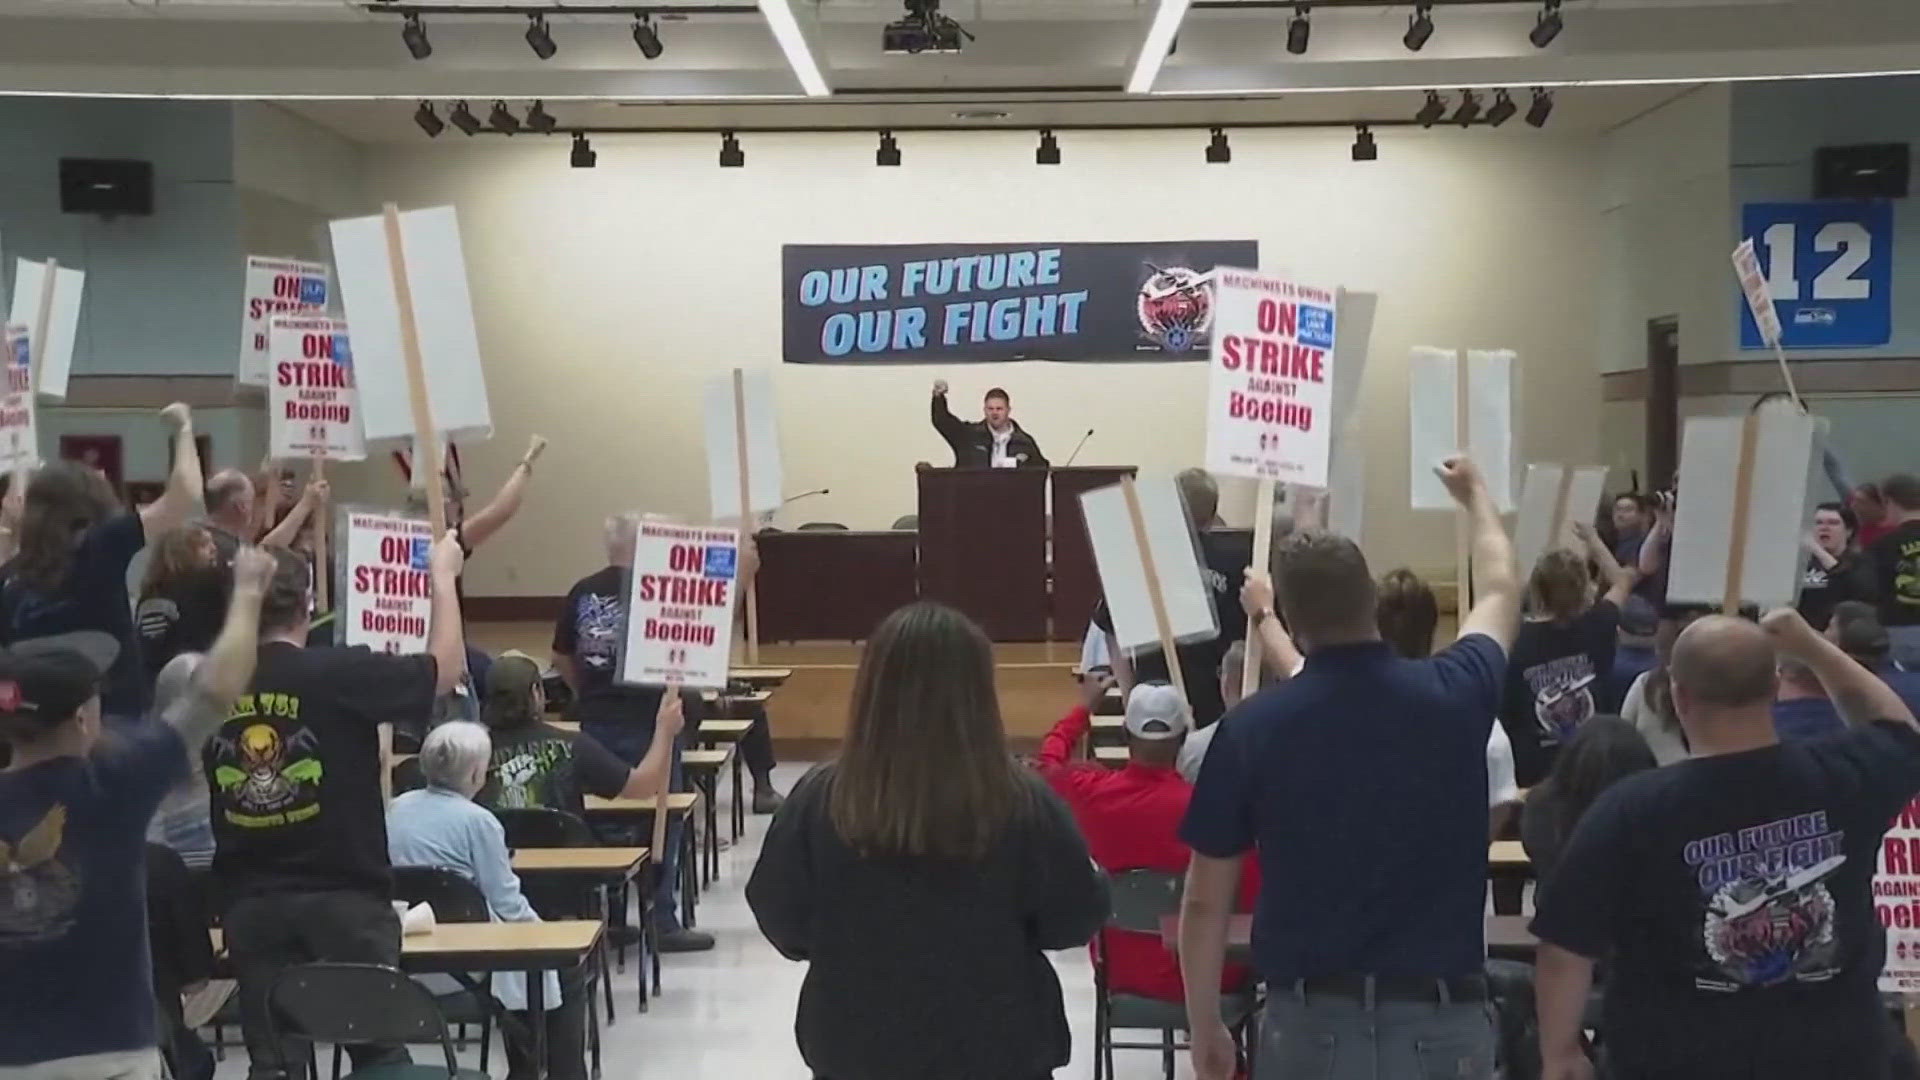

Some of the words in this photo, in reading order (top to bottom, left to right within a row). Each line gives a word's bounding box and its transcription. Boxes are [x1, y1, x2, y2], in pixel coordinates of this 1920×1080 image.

[1763, 221, 1872, 300] 12
[273, 274, 300, 299] ON
[800, 265, 889, 306] OUR
[902, 248, 1062, 297] FUTURE
[1223, 273, 1295, 297] MACHINISTS
[821, 306, 926, 357] OUR
[942, 289, 1089, 346] FIGHT
[1257, 298, 1297, 338] ON
[303, 333, 332, 359] ON
[1222, 335, 1325, 384] STRIKE
[1248, 376, 1298, 397] AGAINST
[285, 400, 350, 424] Boeing
[1229, 391, 1313, 432] Boeing
[642, 526, 702, 541] MACHINISTS
[381, 535, 410, 565] ON
[669, 544, 704, 573] ON
[640, 574, 728, 607] STRIKE
[362, 609, 425, 639] Boeing
[660, 606, 702, 621] AGAINST
[645, 618, 716, 647] Boeing
[1683, 832, 1736, 866] OUR
[1738, 810, 1829, 852] FUTURE
